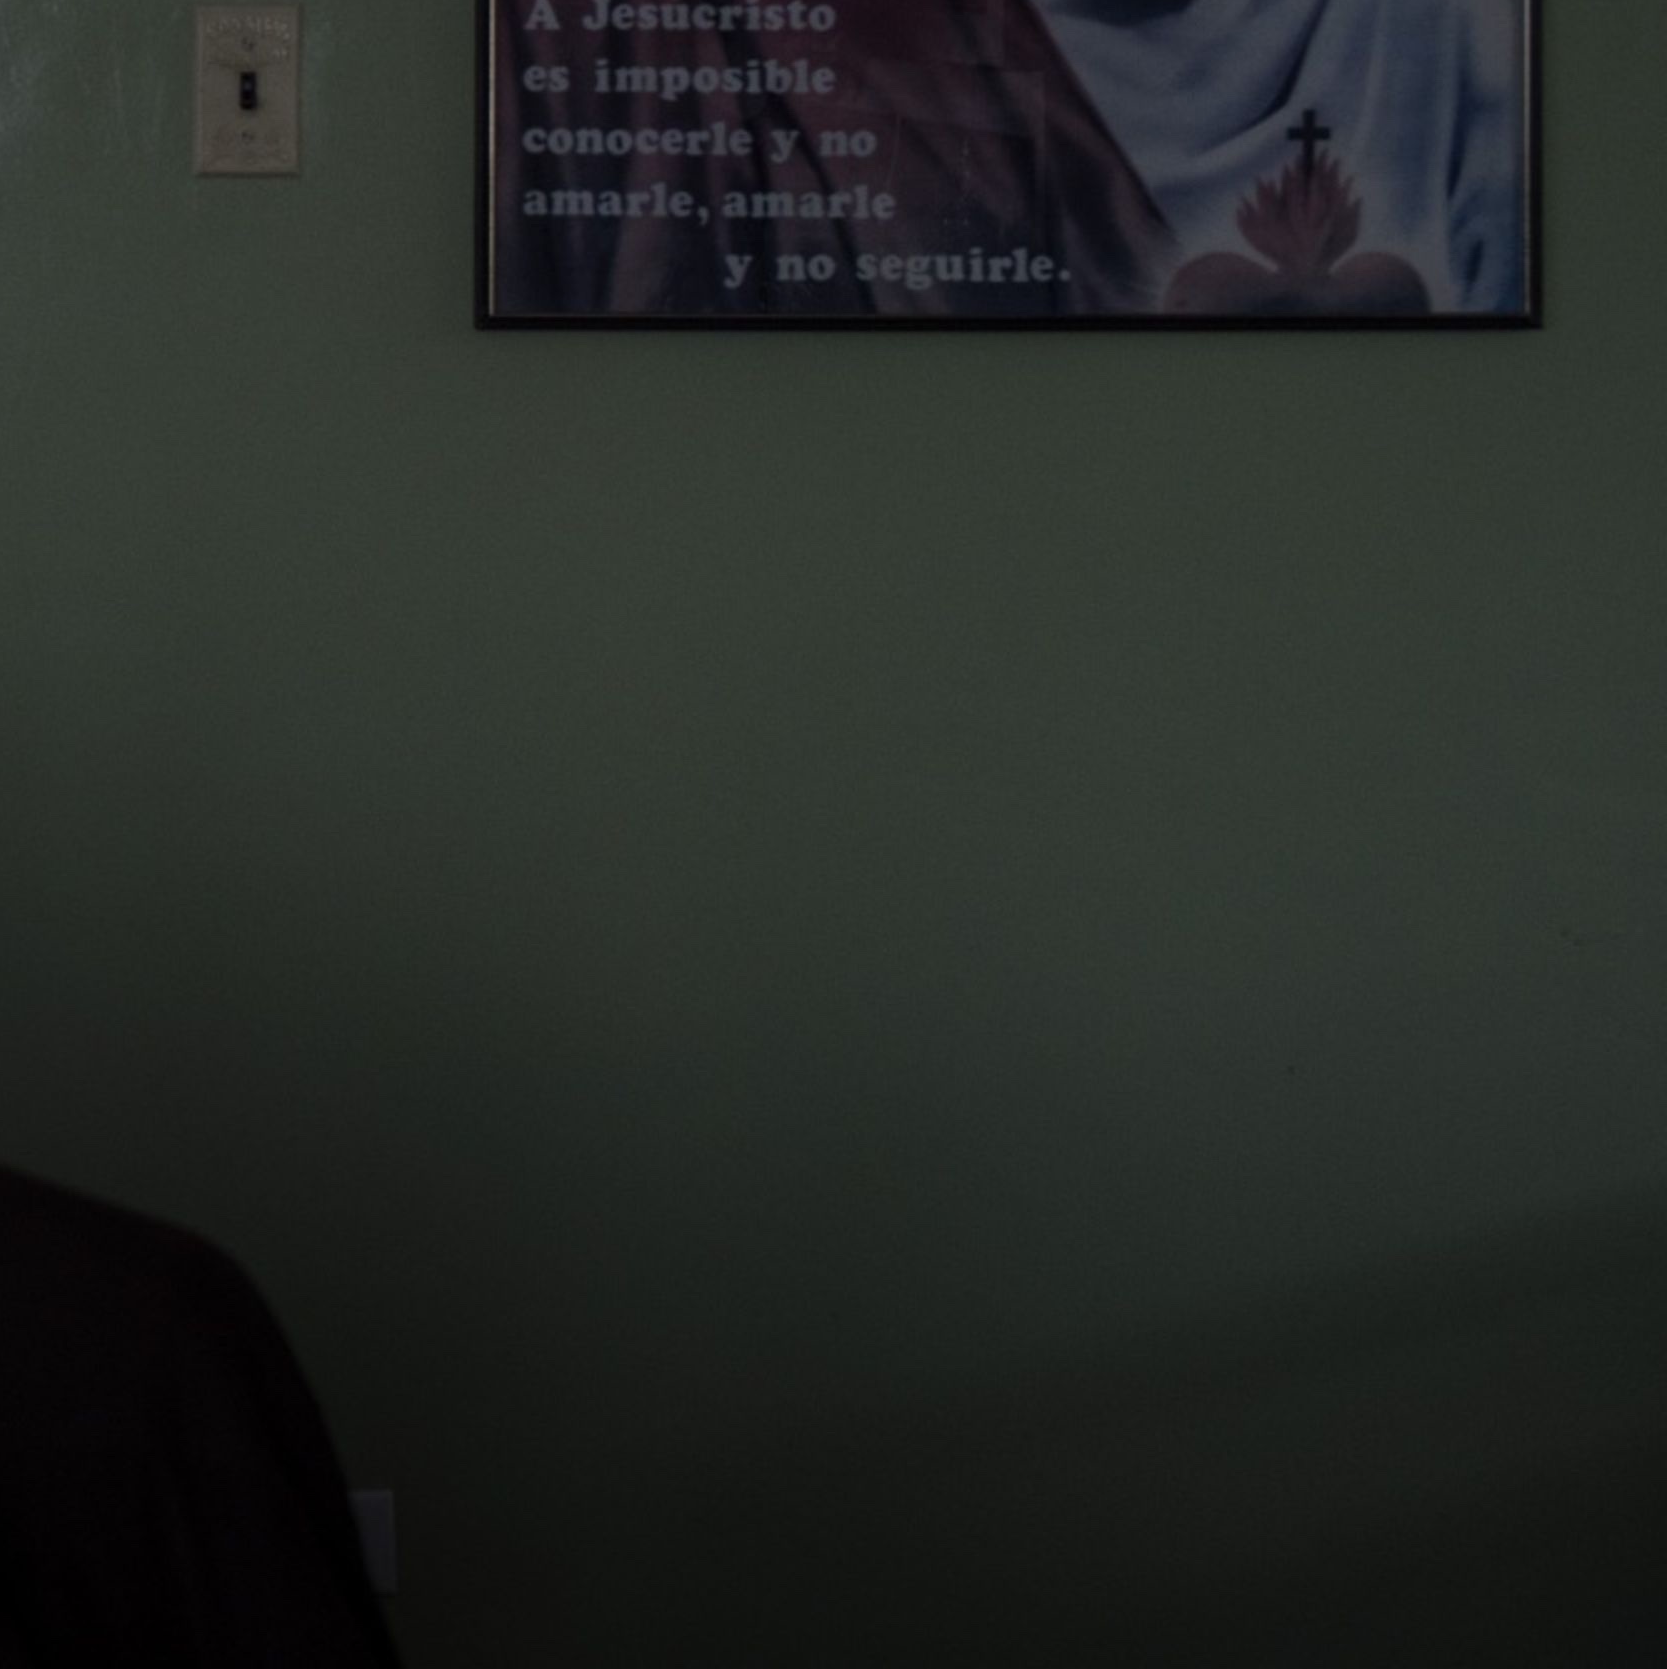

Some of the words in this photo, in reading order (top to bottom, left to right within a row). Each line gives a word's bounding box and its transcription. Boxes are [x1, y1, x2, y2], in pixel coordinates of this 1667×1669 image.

[523, 65, 570, 94] es
[594, 58, 836, 101] imposible
[523, 120, 753, 157] conocerle
[770, 129, 801, 165] y
[819, 130, 877, 157] no
[523, 182, 710, 226] amarle,
[720, 185, 896, 220] amarle
[723, 253, 754, 290] y
[776, 253, 836, 282] no
[856, 246, 1072, 291] seguirle.
